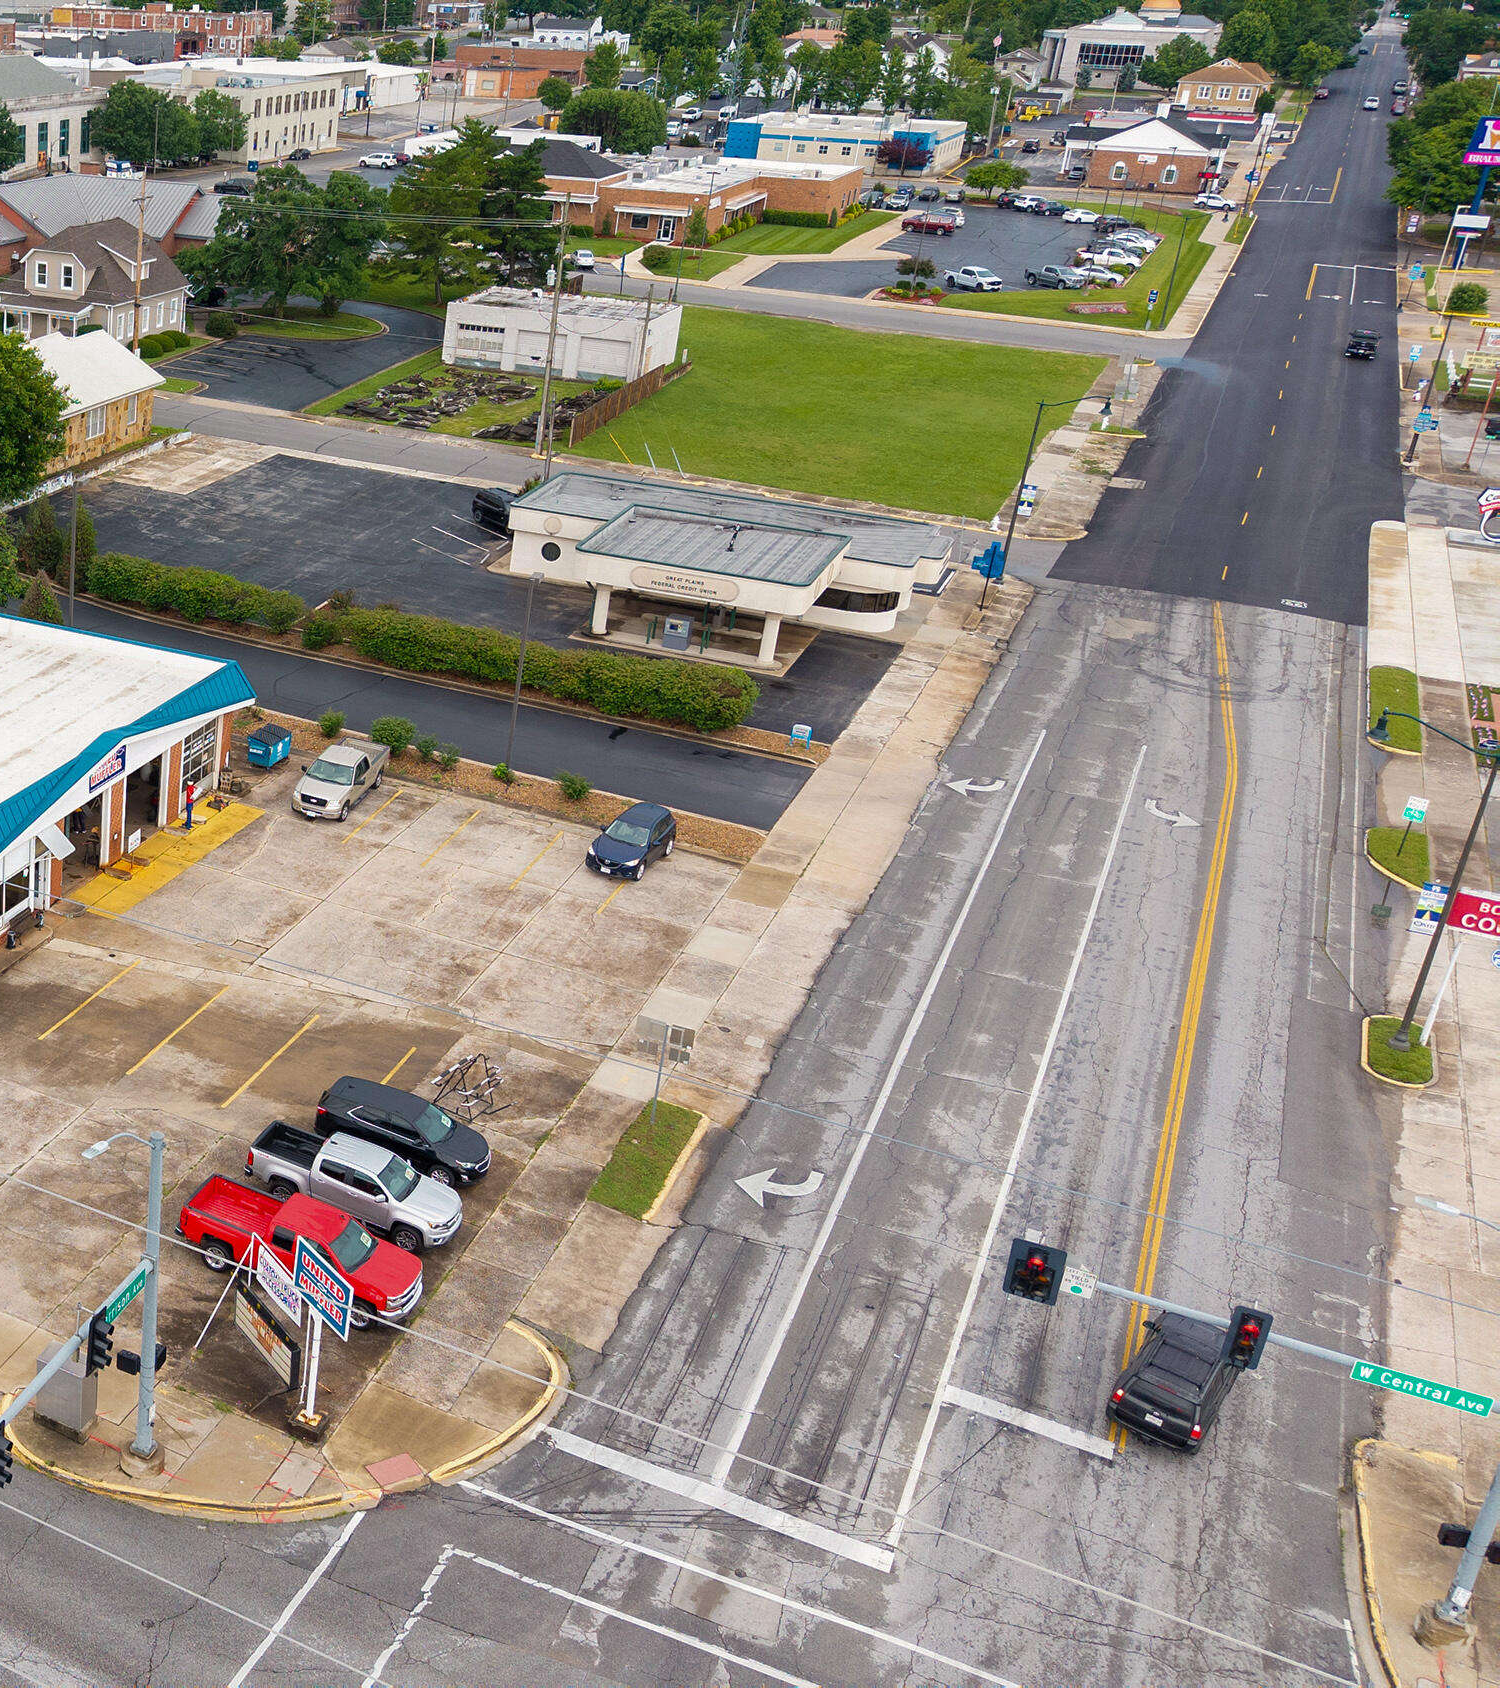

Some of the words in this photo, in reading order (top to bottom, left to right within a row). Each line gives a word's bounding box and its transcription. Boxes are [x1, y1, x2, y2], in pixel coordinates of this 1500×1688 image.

[651, 580, 675, 589] FEDERAL
[1461, 913, 1500, 934] CO
[302, 1252, 345, 1302] UNITED
[1071, 1274, 1088, 1282] YIELD
[105, 1292, 130, 1322] rrison
[132, 1280, 143, 1295] Ave
[299, 1272, 343, 1326] MUFFLER
[1360, 1366, 1374, 1379] W
[1381, 1372, 1450, 1402] Central
[1456, 1396, 1485, 1412] Ave
